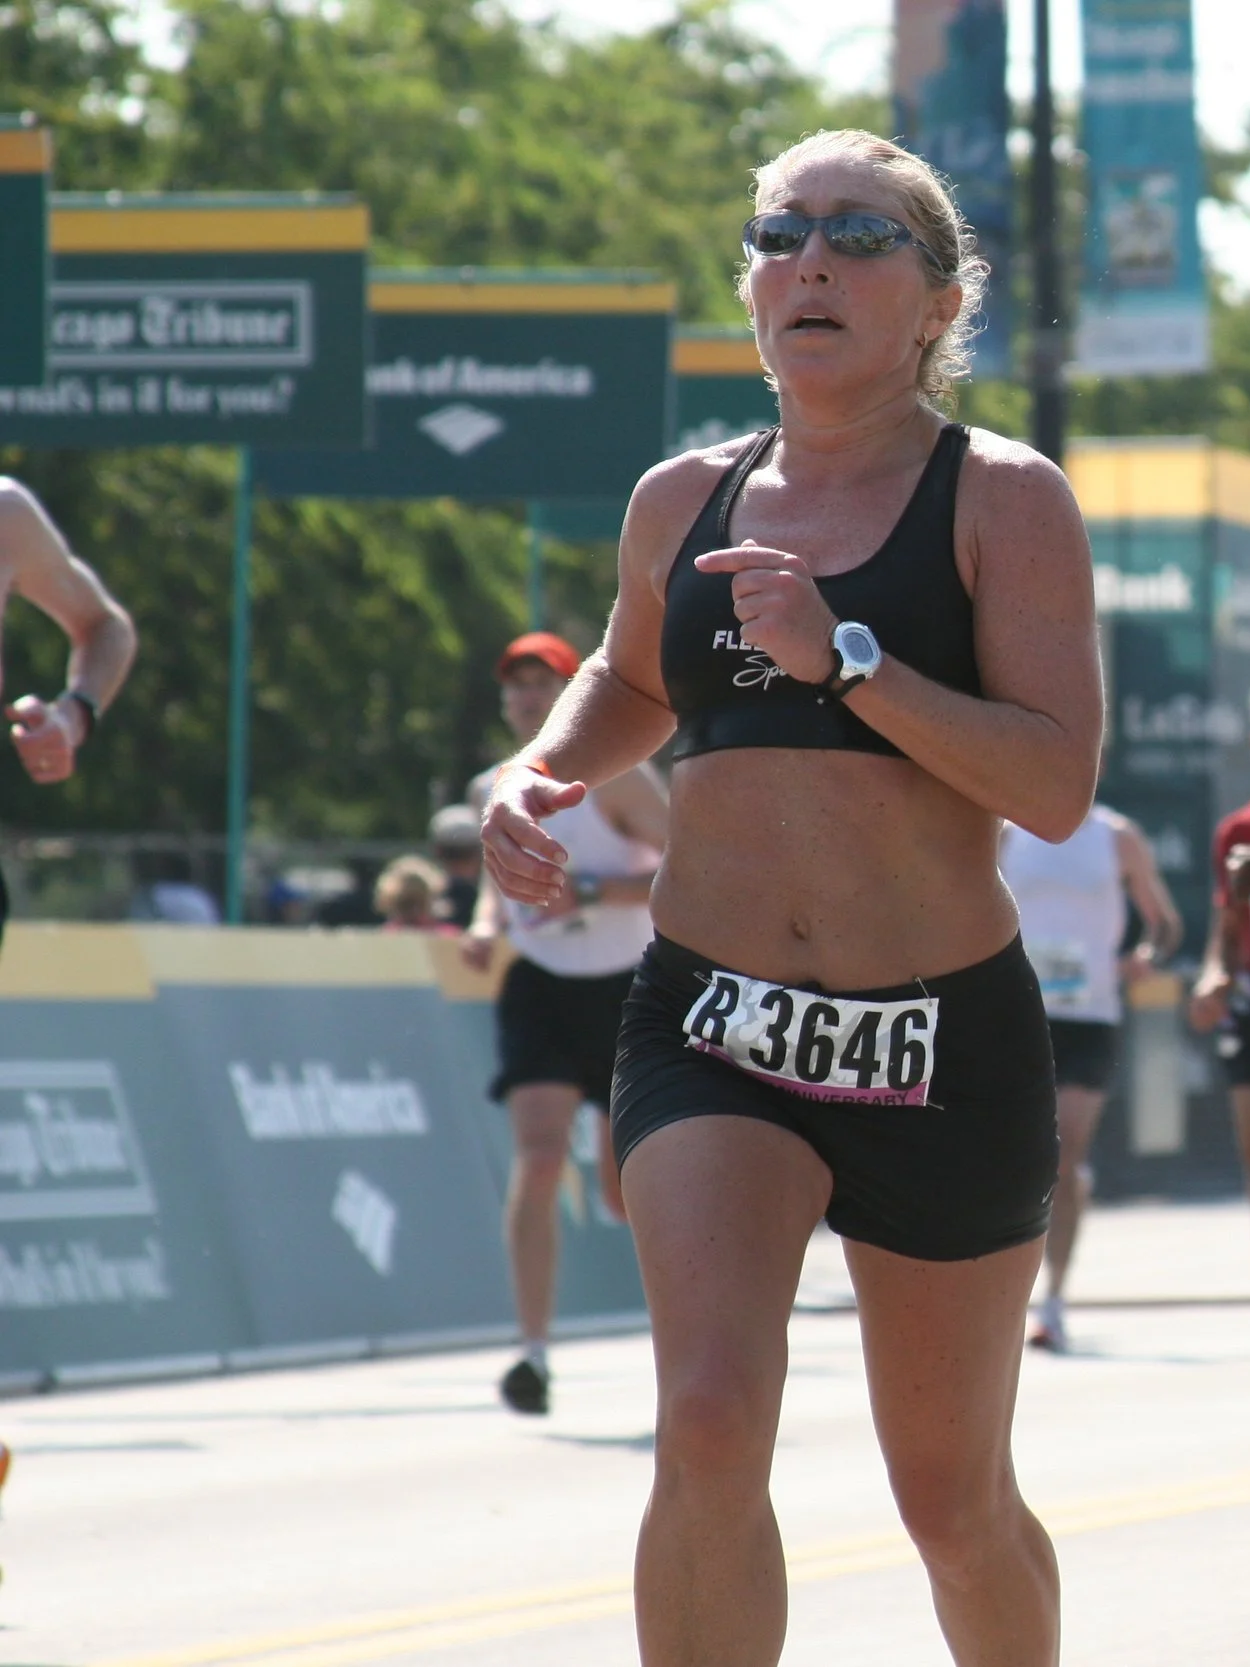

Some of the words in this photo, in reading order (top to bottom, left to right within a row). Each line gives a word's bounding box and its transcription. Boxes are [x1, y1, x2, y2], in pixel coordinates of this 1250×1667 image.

[140, 295, 292, 347] Tribune
[166, 374, 213, 414] for
[455, 353, 596, 396] America
[690, 975, 741, 1047] R
[748, 988, 930, 1092] 3646
